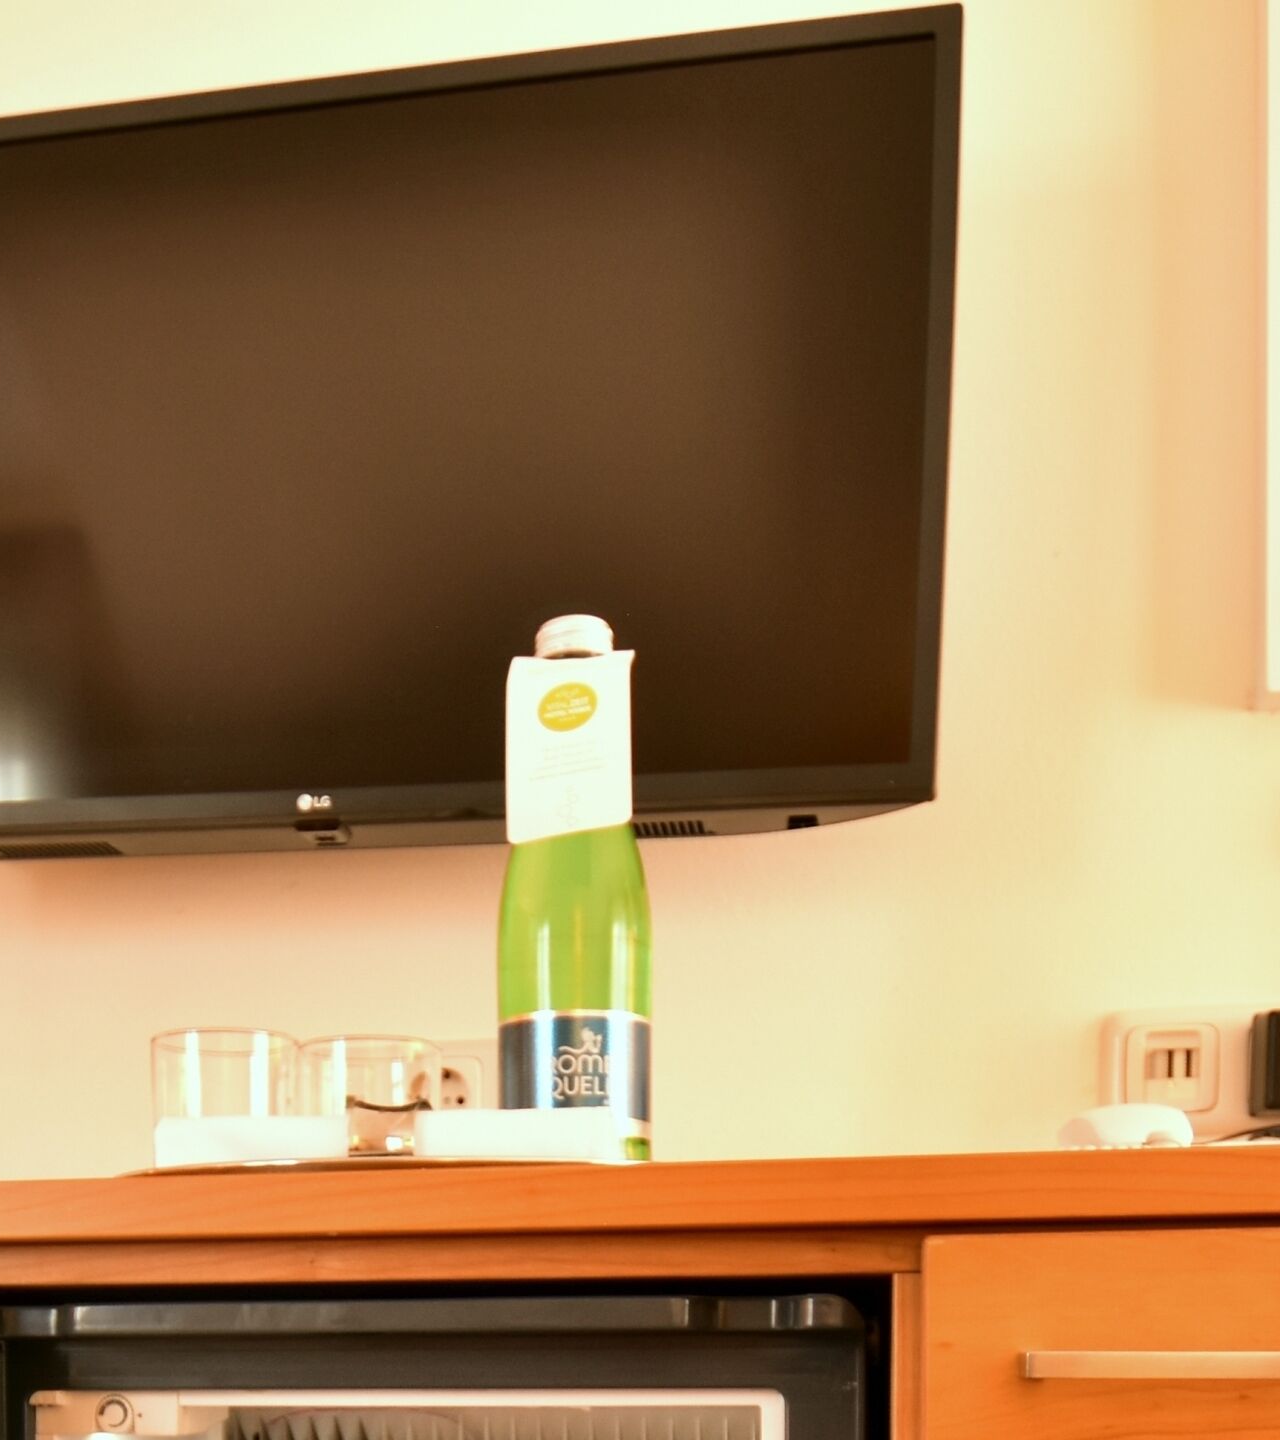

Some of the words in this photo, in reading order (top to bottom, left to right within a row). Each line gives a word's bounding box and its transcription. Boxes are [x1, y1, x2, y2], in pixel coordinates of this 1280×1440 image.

[313, 795, 331, 807] LG
[551, 1054, 609, 1074] OM
[552, 1075, 608, 1100] QUEL
